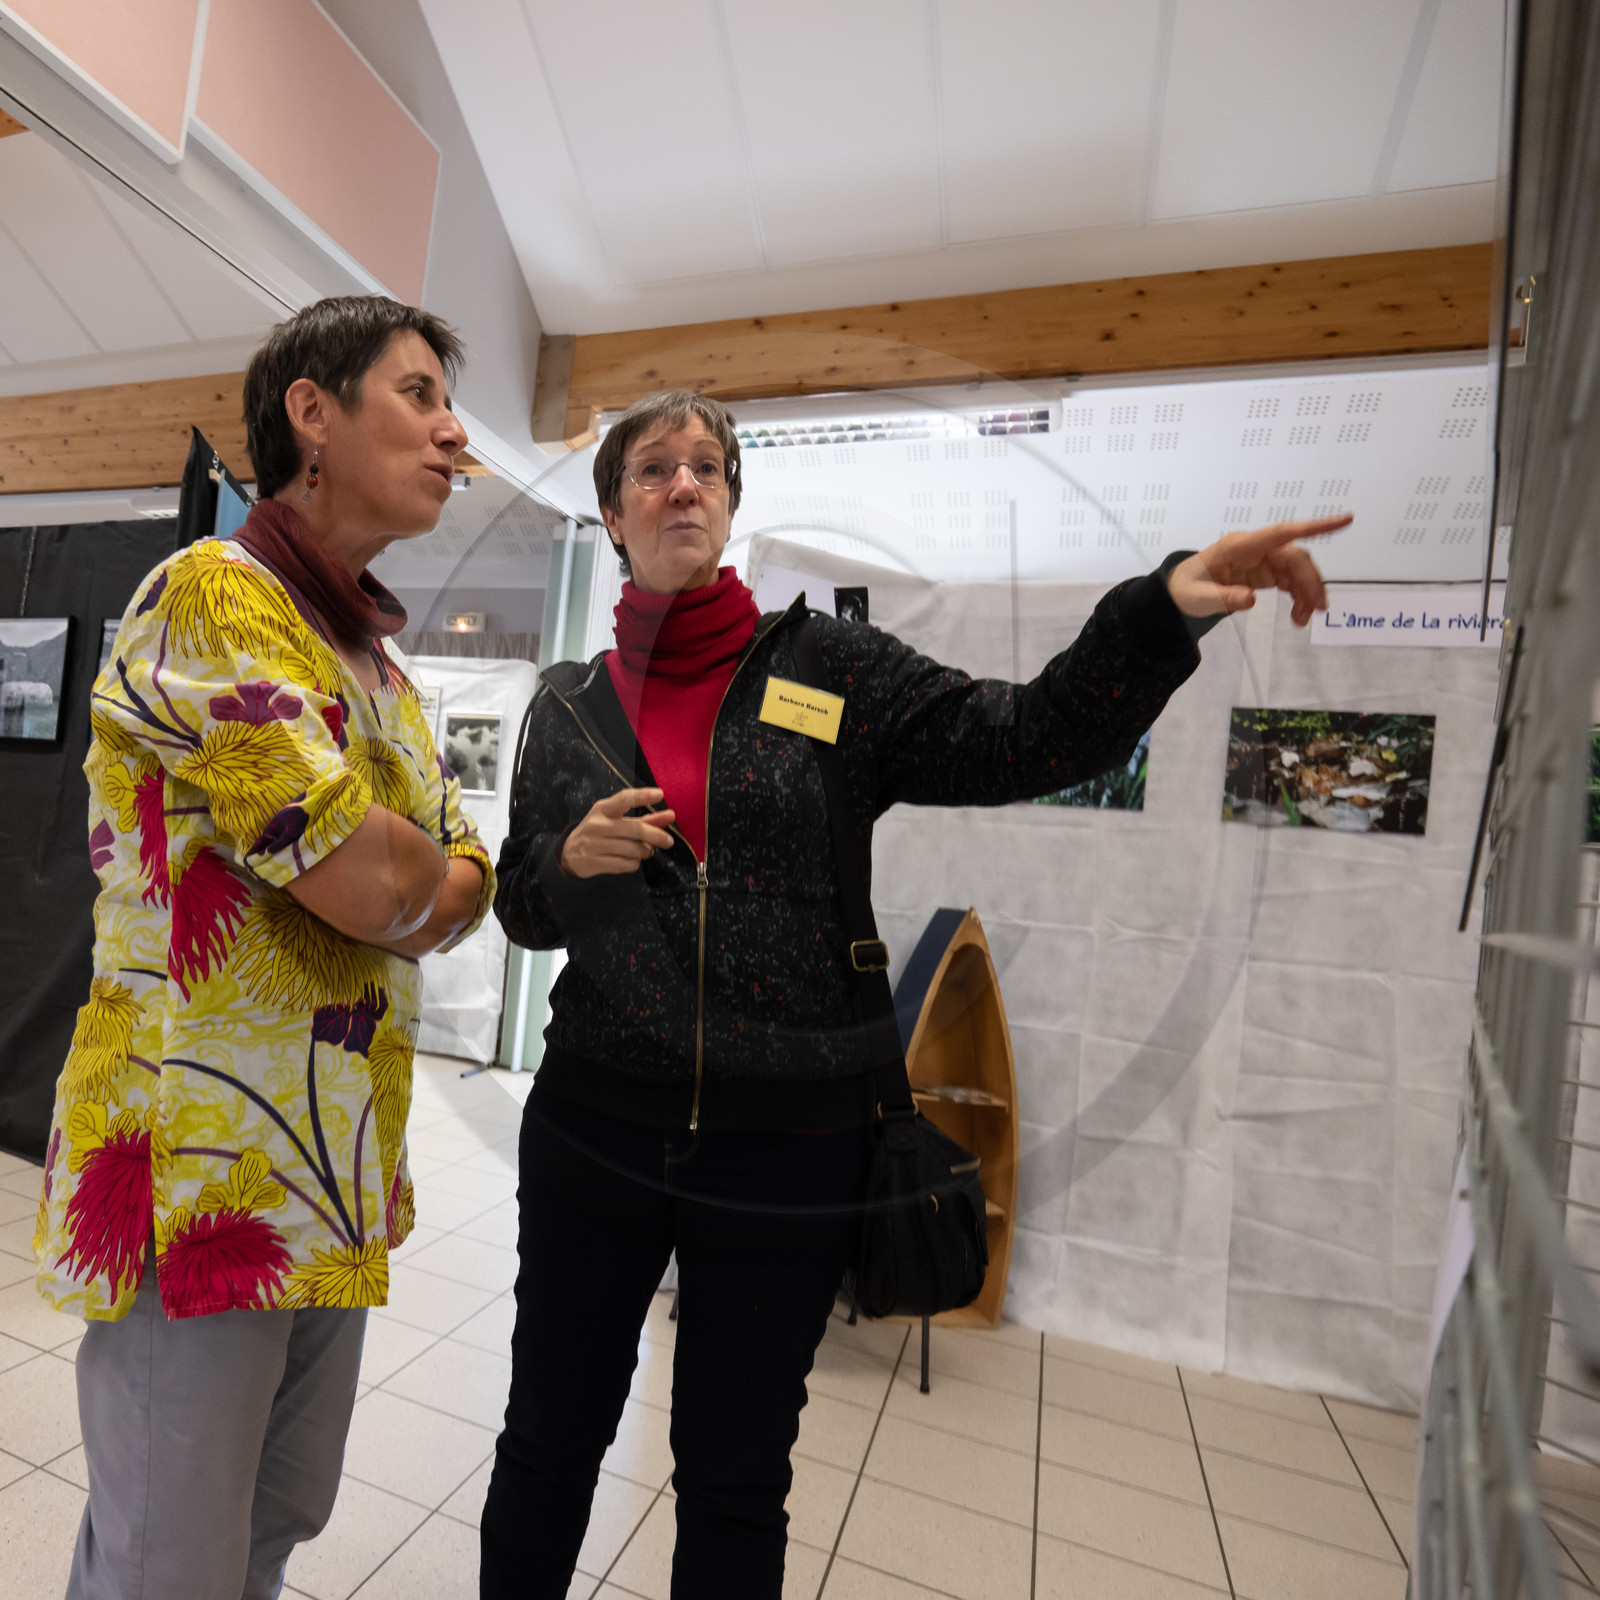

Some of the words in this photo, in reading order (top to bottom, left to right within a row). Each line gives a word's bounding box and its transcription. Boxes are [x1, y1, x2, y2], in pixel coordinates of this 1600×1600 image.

[1325, 611, 1385, 628] L'âme
[1391, 611, 1415, 628] de
[779, 695, 804, 707] Barbara
